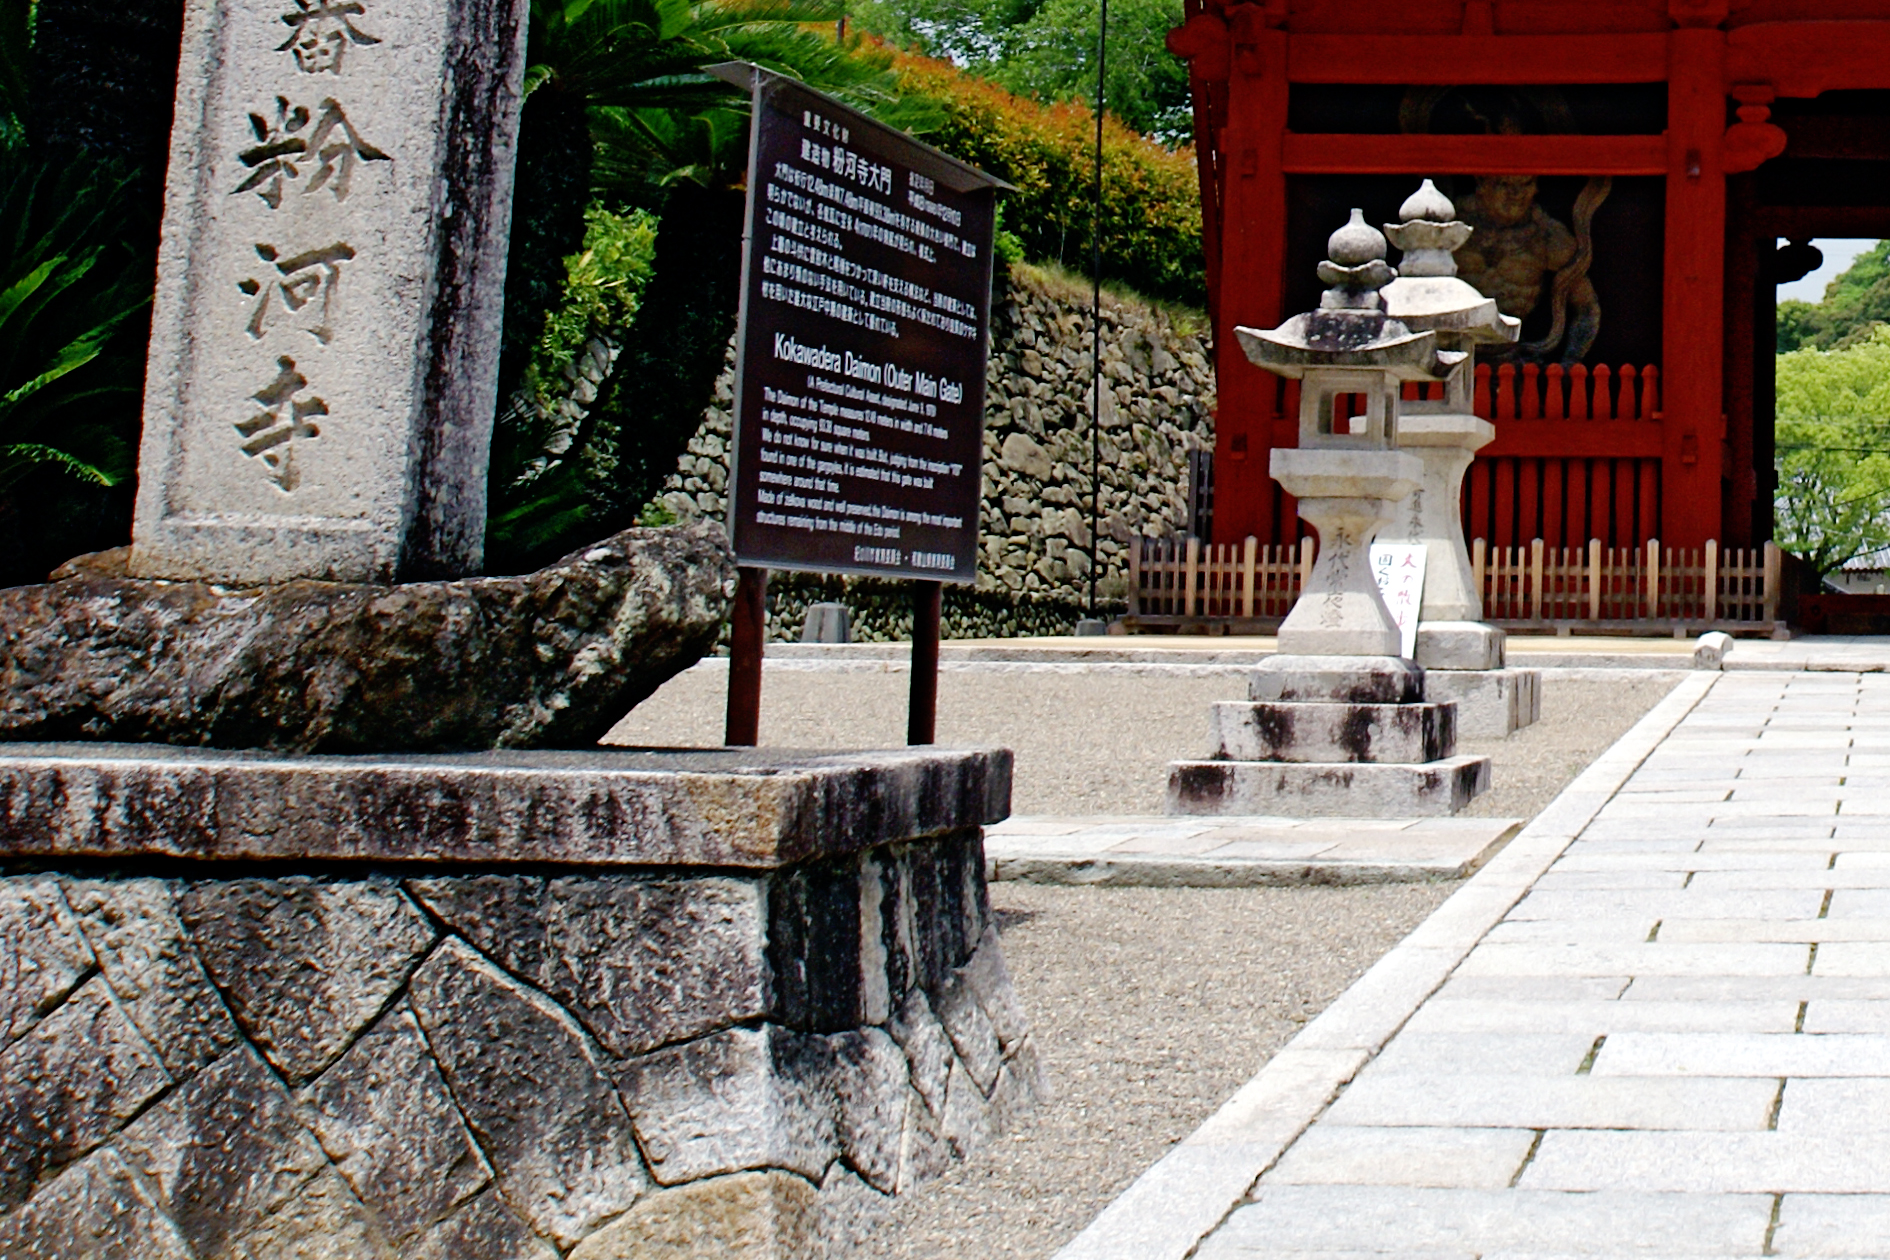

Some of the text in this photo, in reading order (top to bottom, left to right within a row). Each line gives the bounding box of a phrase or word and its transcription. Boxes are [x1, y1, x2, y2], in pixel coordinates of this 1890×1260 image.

[774, 332, 962, 404] Kokawadera Daimon (Outer Main Gate)
[764, 386, 776, 402] The
[777, 389, 799, 406] Daimon
[808, 397, 817, 411] the
[819, 399, 838, 415] Temple
[876, 415, 893, 427] meters
[913, 423, 923, 434] and
[762, 427, 772, 442] We
[782, 434, 792, 445] not
[793, 434, 809, 447] know
[820, 441, 832, 452] sure
[833, 443, 848, 455] when
[854, 448, 865, 458] was
[833, 424, 851, 437] square
[759, 471, 792, 485] somewhere
[793, 476, 813, 489] around
[814, 477, 825, 490] that
[760, 447, 777, 463] found
[786, 454, 797, 466] one
[806, 456, 816, 469] the
[901, 474, 912, 487] gate
[913, 477, 922, 487] was
[757, 488, 775, 503] Made
[807, 498, 822, 509] wood
[823, 500, 834, 511] and
[835, 500, 846, 512] well
[815, 516, 827, 529] from
[828, 518, 837, 531] the
[864, 523, 872, 535] the
